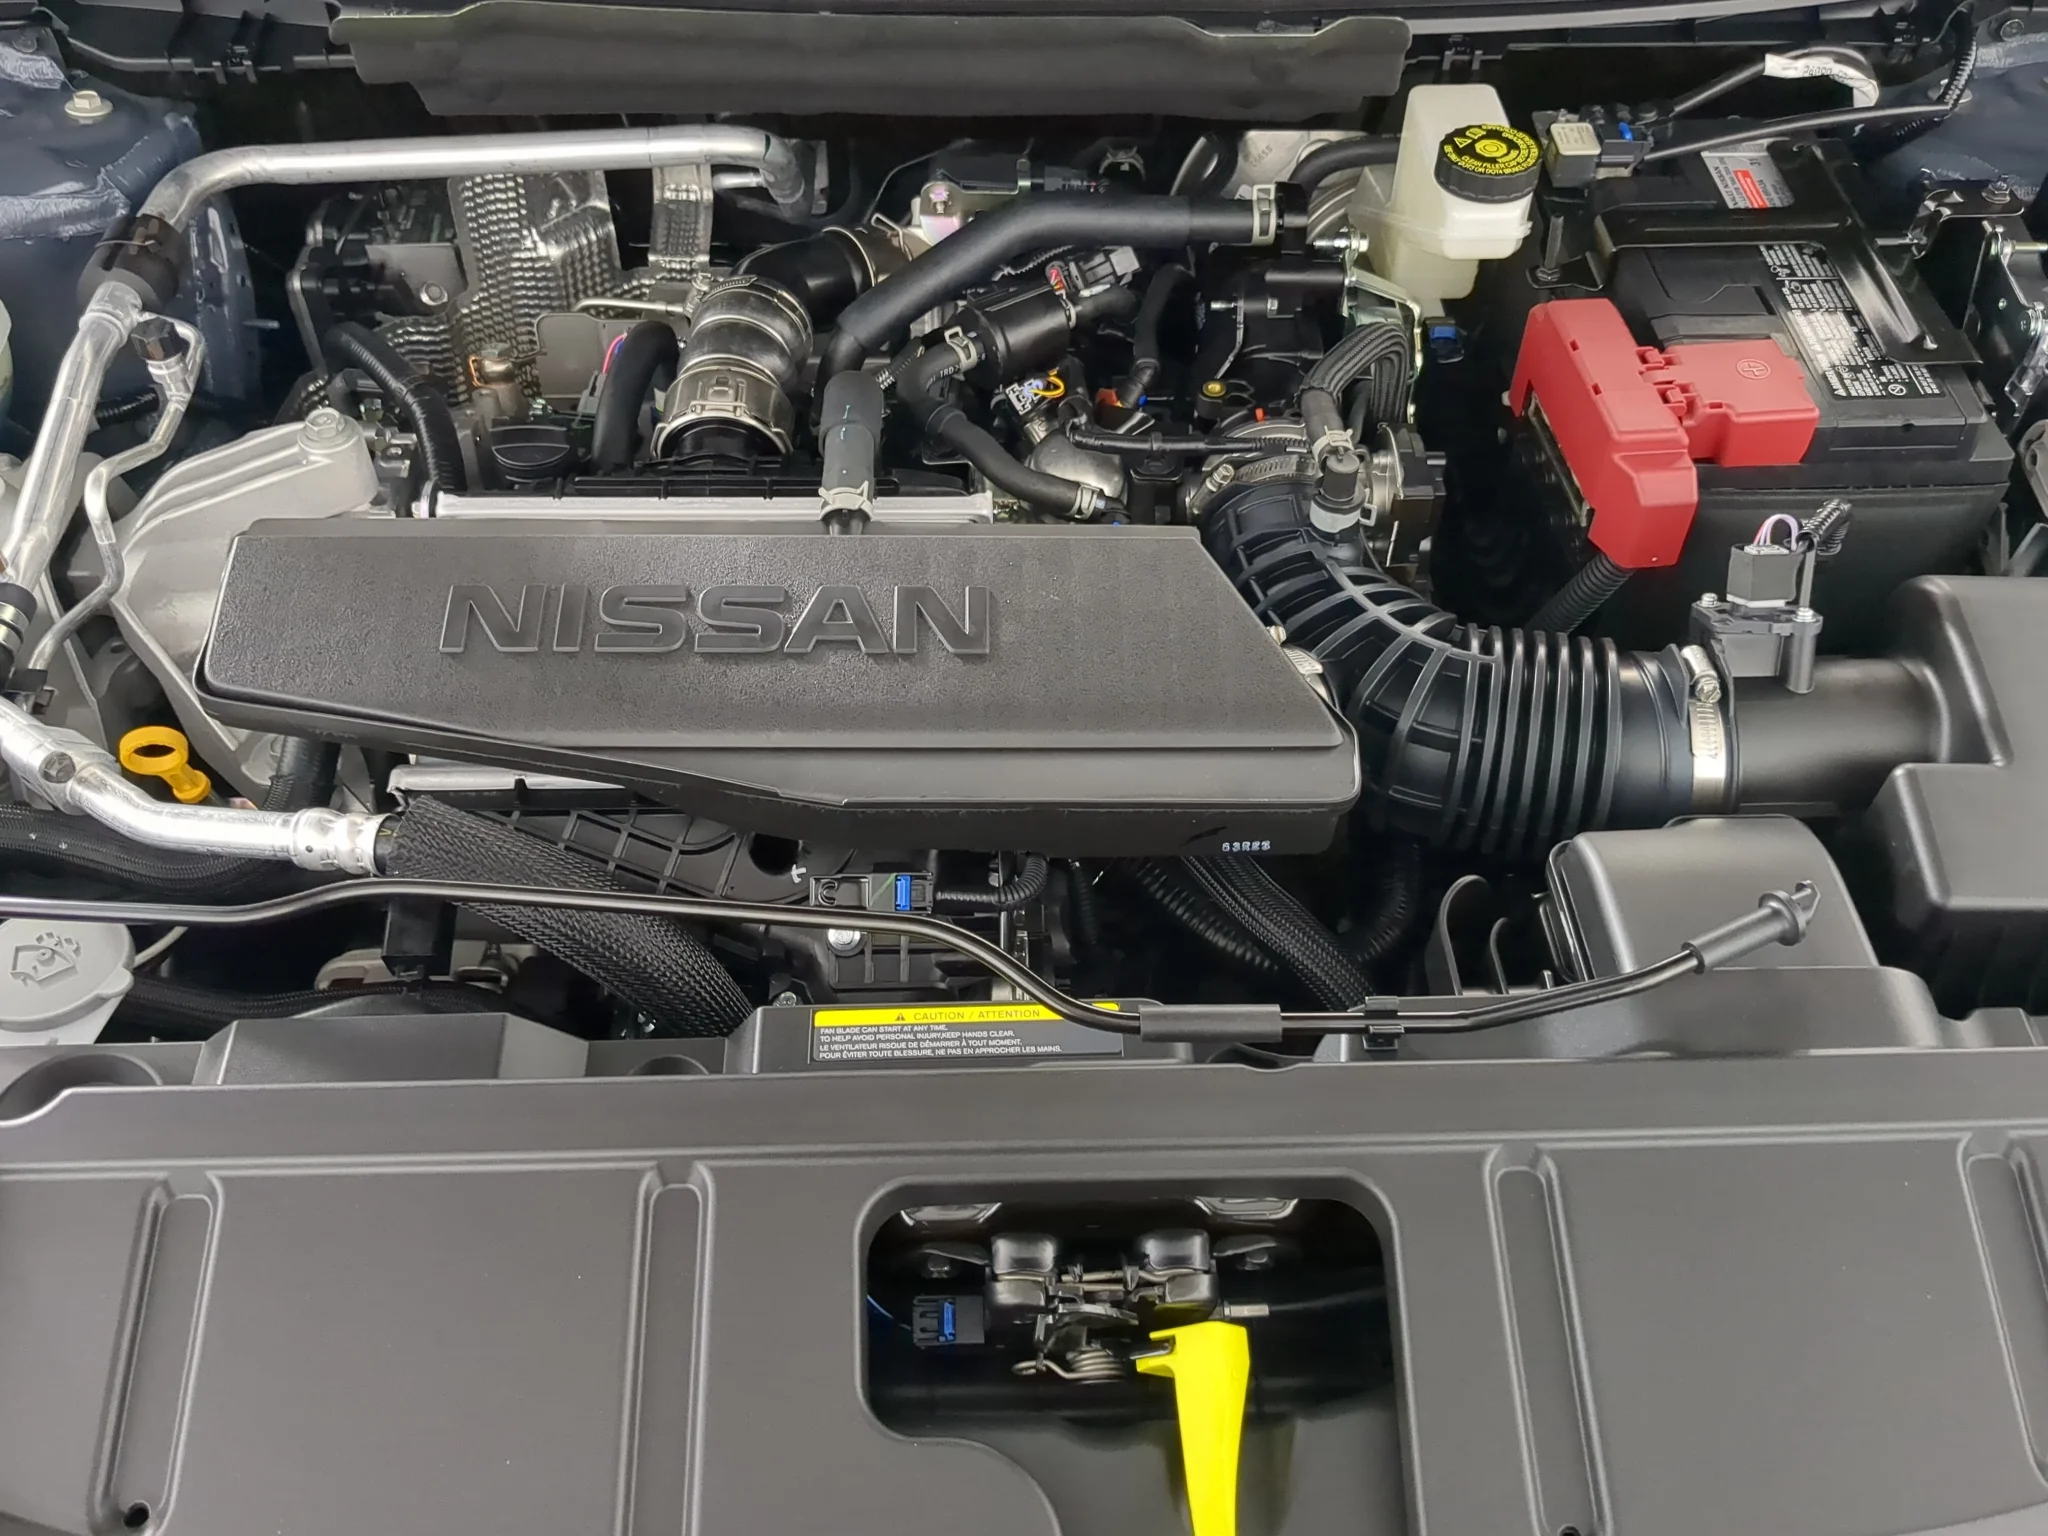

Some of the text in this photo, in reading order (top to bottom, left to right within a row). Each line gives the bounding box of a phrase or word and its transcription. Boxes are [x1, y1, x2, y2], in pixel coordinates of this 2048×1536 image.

[439, 583, 991, 655] NISSAN
[913, 1011, 965, 1021] CAUTION
[977, 1009, 1040, 1019] ATTENTION
[820, 1027, 835, 1035] FAN
[836, 1026, 860, 1034] BLADE
[879, 1025, 901, 1033] START
[831, 1034, 852, 1042] HELP
[876, 1033, 915, 1041] PERSONAL
[961, 1030, 988, 1038] HANDS
[830, 1043, 878, 1051] VENTILATEUR
[879, 1041, 907, 1049] RISQUE
[968, 1039, 987, 1047] TOUT
[963, 1047, 974, 1055] EN
[974, 1046, 1020, 1054] APPROCHER
[1021, 1045, 1036, 1053] LES
